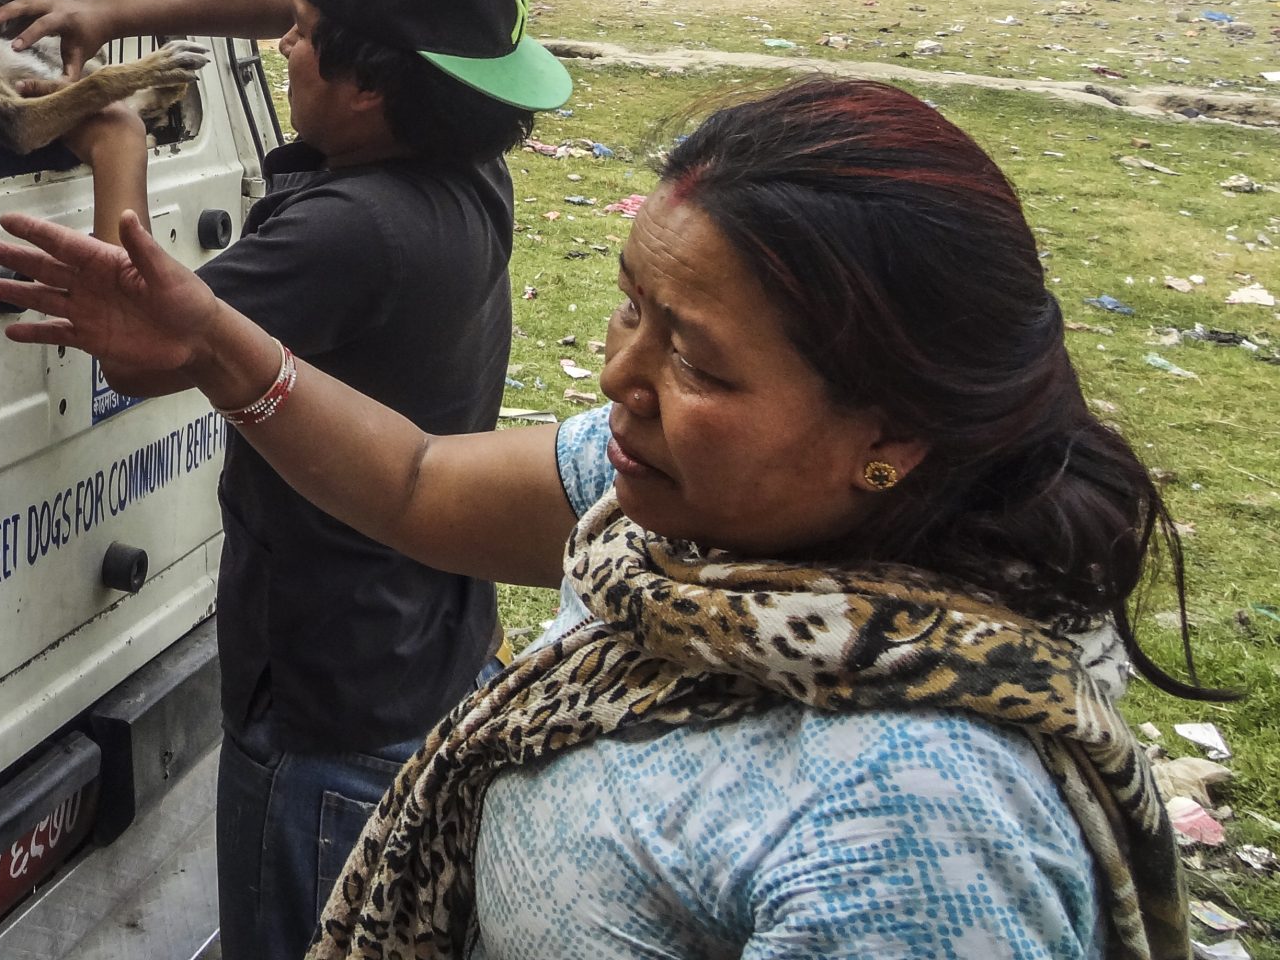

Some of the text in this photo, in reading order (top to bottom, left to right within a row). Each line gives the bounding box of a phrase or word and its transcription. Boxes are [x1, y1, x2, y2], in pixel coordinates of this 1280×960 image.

[27, 488, 72, 565] DOGS
[75, 470, 104, 537] FOR
[109, 427, 184, 516] COMMUNITY
[186, 411, 227, 473] BENEFI
